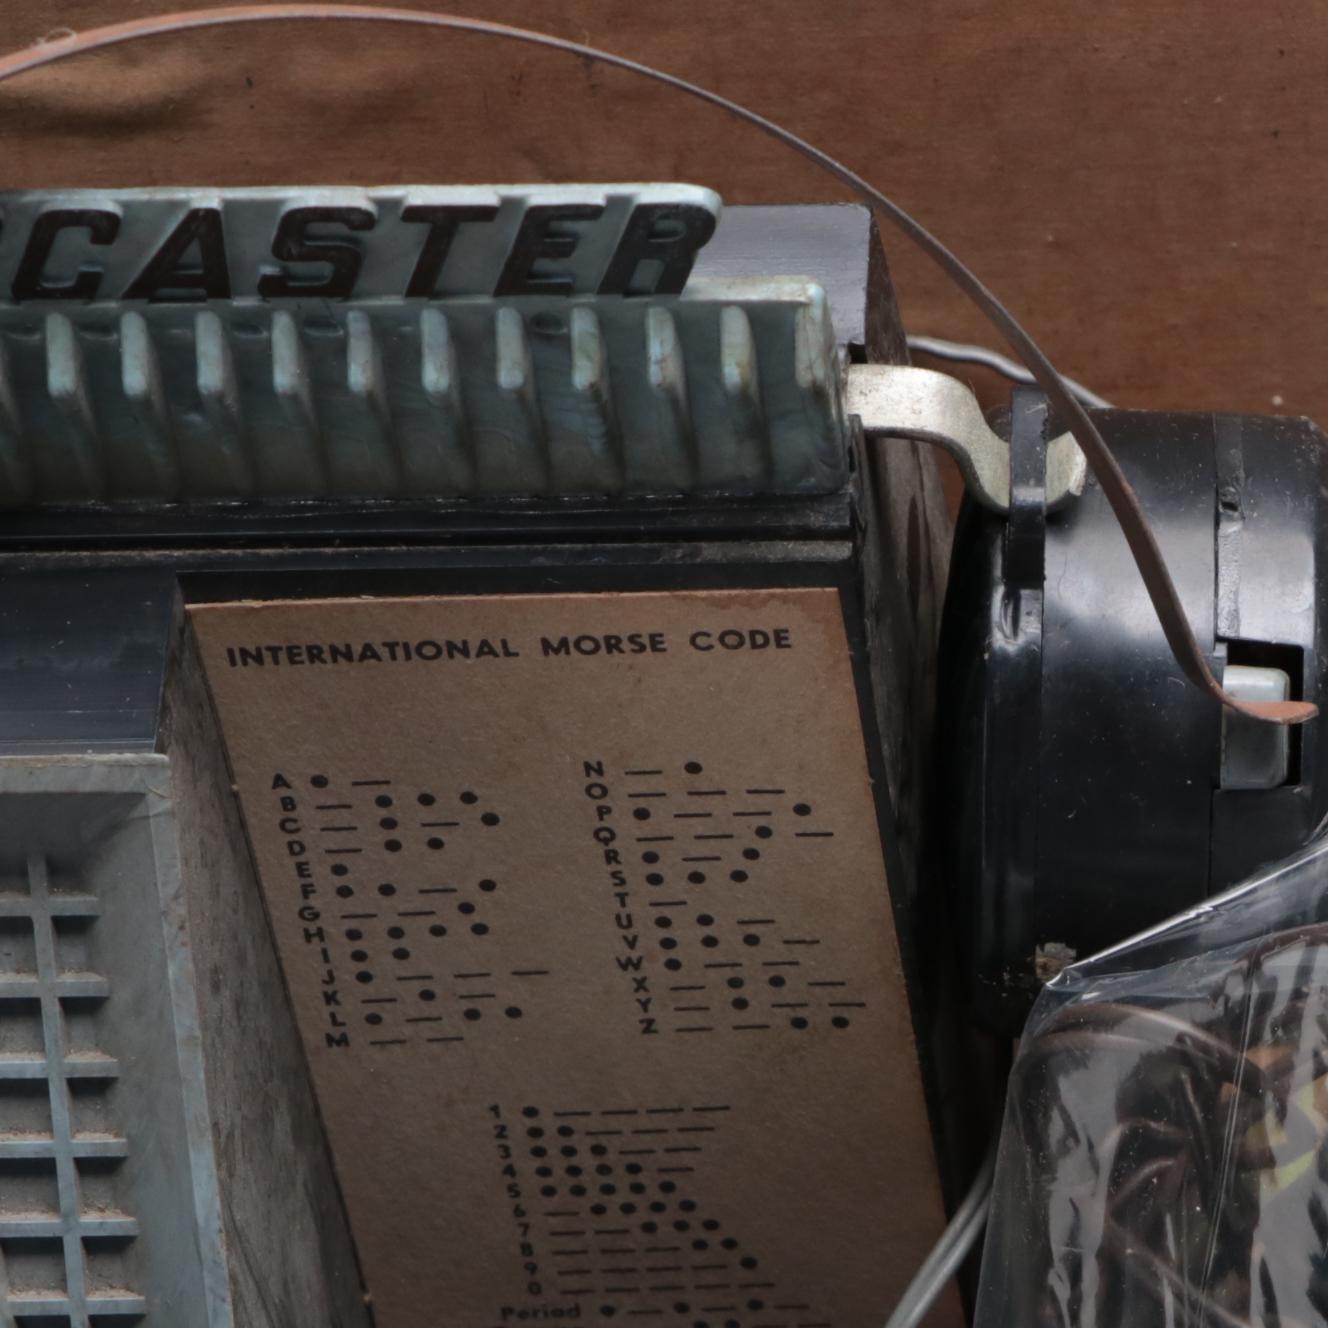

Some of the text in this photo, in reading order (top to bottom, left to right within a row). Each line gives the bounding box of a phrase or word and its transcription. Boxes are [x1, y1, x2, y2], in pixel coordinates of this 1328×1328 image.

[0, 201, 717, 302] CASTER
[227, 629, 792, 667] INTERNATIONAL MORSE CODE
[584, 761, 604, 777] N
[272, 774, 292, 789] A
[585, 783, 608, 800] O
[280, 796, 296, 812] B
[596, 805, 612, 821] P
[279, 817, 301, 834] C
[593, 827, 616, 846] Q
[287, 840, 306, 856] D
[604, 849, 621, 865] R
[295, 861, 312, 878] E
[610, 871, 626, 887] S
[301, 883, 316, 900] F
[614, 892, 629, 908] T
[298, 906, 320, 922] G
[615, 913, 633, 929] U
[303, 927, 325, 943] H
[622, 935, 638, 950] V
[321, 948, 330, 963] I
[616, 956, 643, 971] W
[322, 969, 335, 985] J
[632, 976, 649, 993] X
[323, 990, 341, 1005] K
[636, 998, 651, 1013] Y
[330, 1012, 346, 1027] L
[639, 1018, 658, 1034] Z
[325, 1032, 349, 1048] M
[489, 1104, 500, 1119] 1
[494, 1125, 508, 1140] 2
[497, 1144, 511, 1160] 3
[502, 1164, 517, 1178] 4
[507, 1183, 522, 1198] 5
[513, 1204, 526, 1218] 6
[518, 1222, 530, 1237] 7
[501, 1303, 581, 1322] Period
